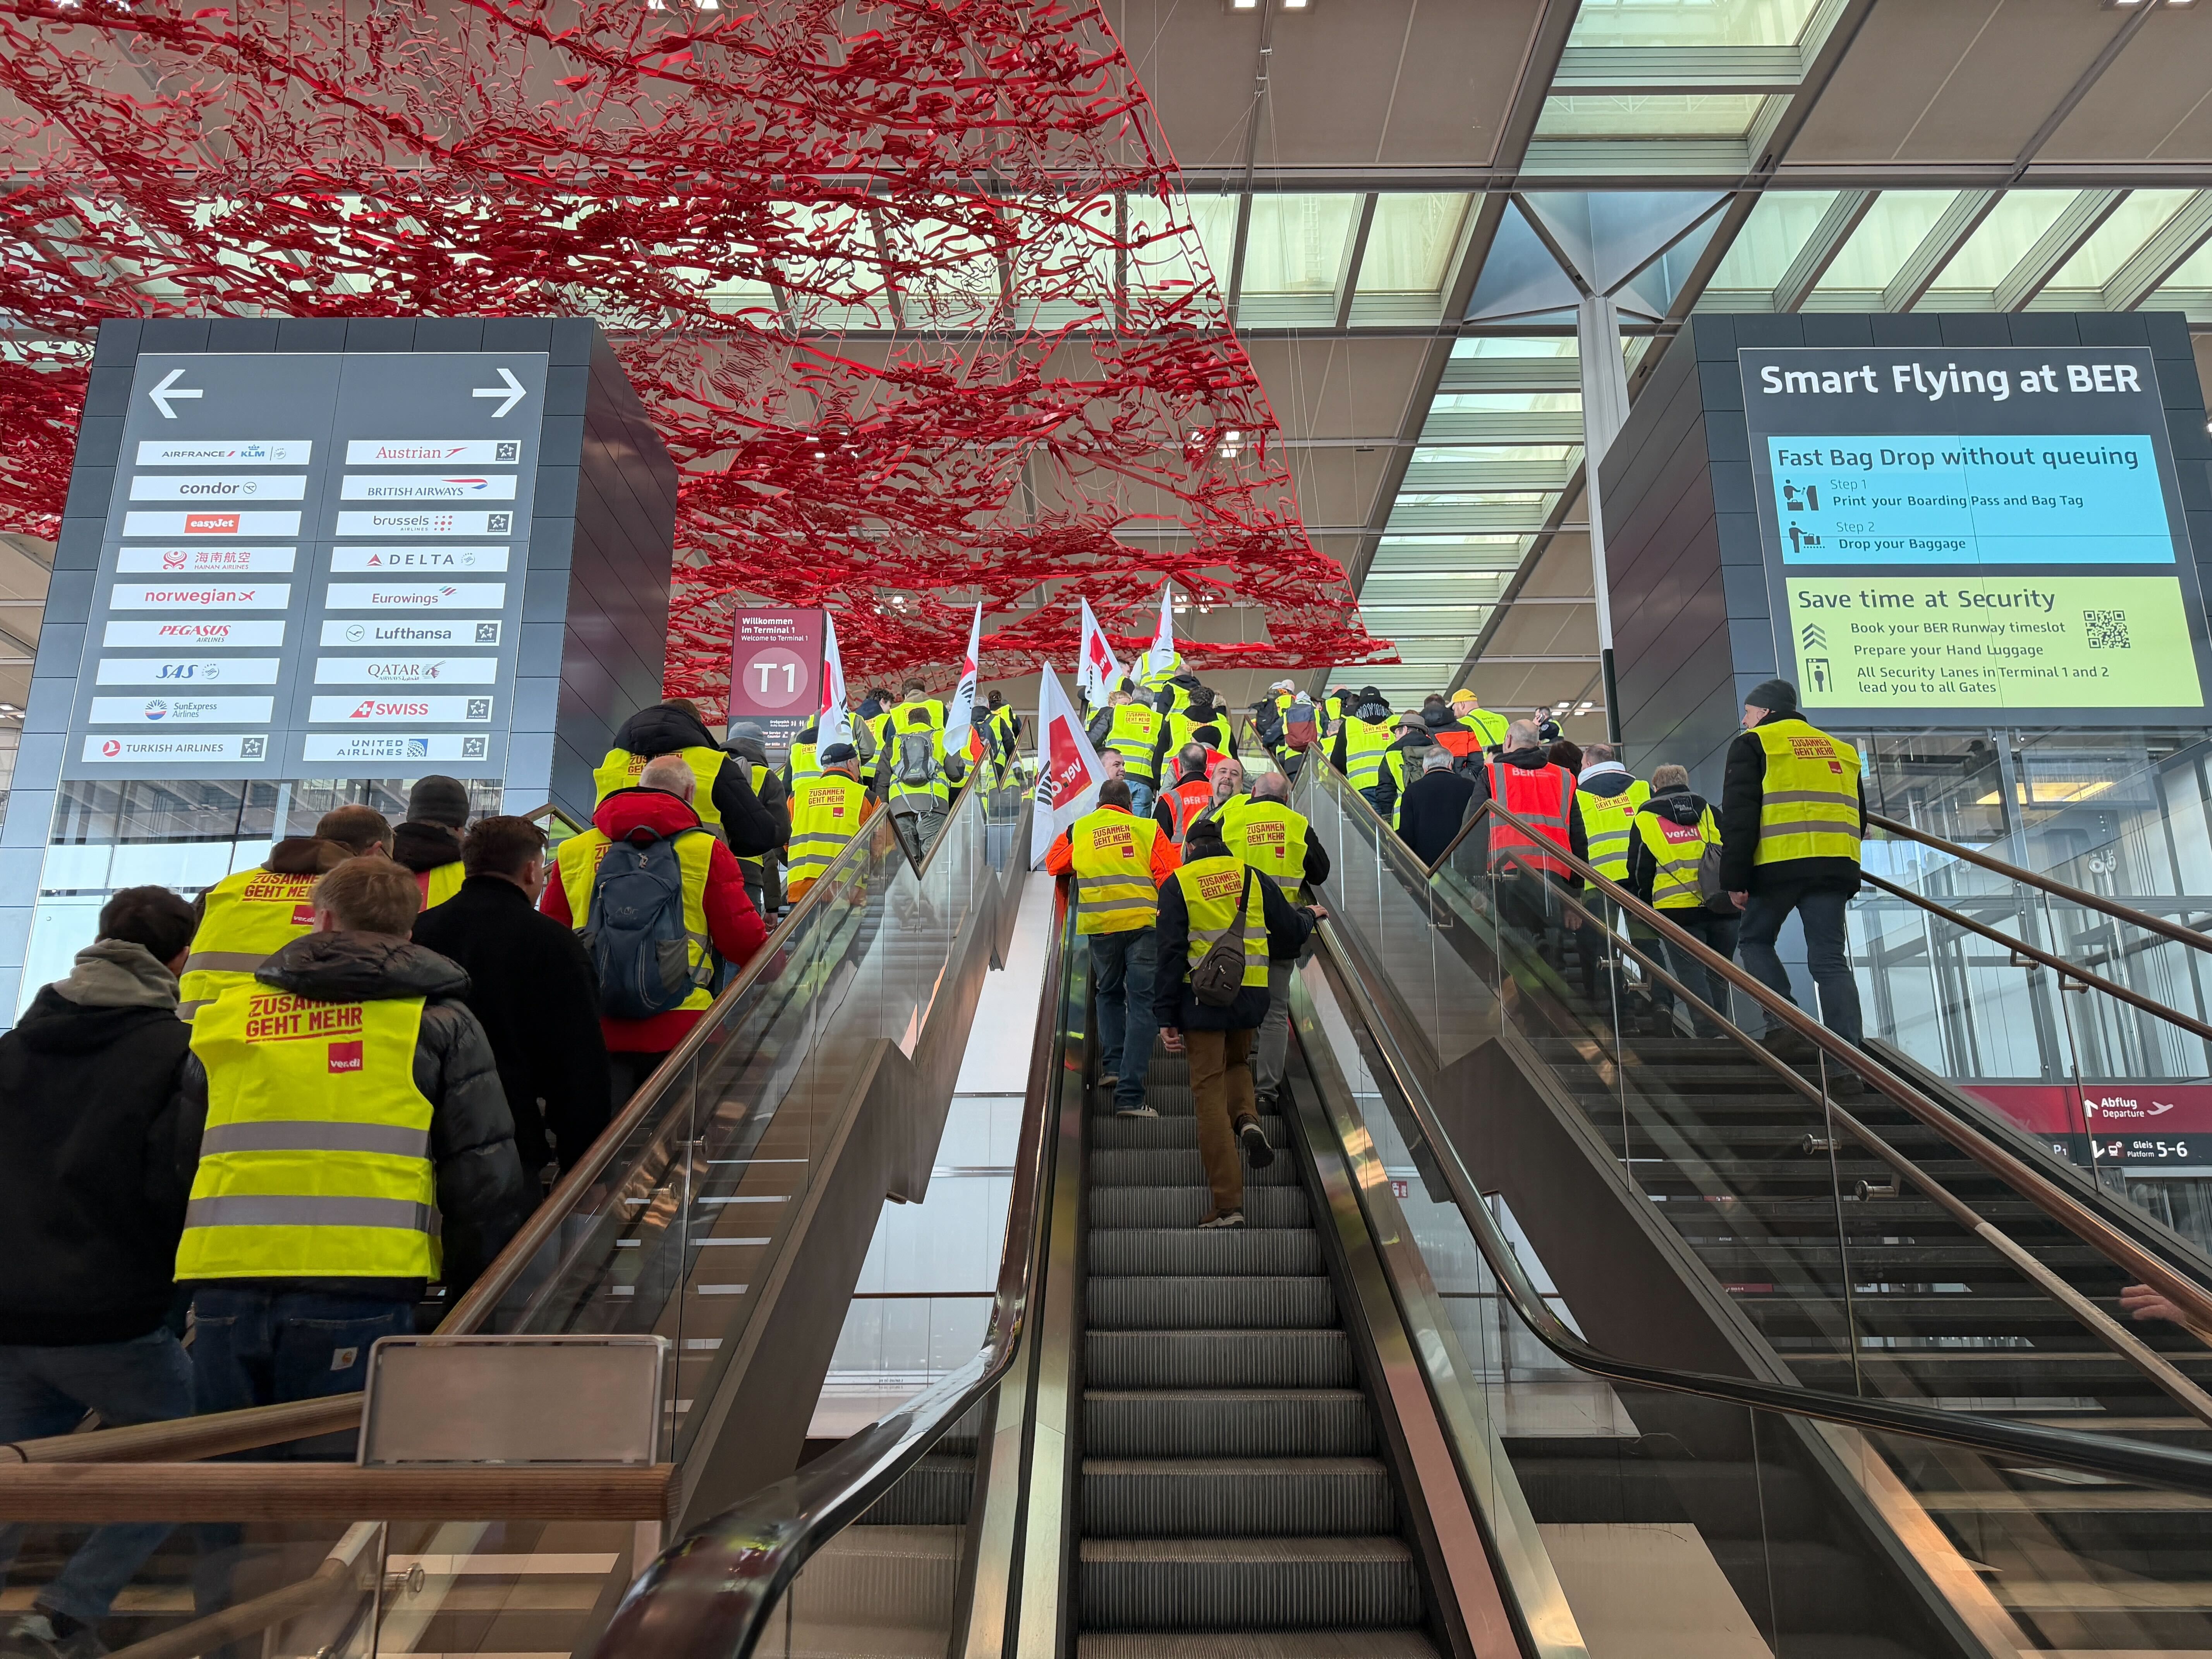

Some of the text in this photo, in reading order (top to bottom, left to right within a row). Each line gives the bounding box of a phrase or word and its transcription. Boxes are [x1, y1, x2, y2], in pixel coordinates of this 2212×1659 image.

[1761, 363, 2141, 401] Smart Flying at BER
[375, 447, 441, 459] Austrian
[1778, 447, 2138, 471] Fast Bag Drop without queuing
[180, 482, 240, 494] condor
[1831, 479, 1867, 491] Step 1
[368, 487, 464, 496] BRITISH AIRWAYS
[1833, 496, 2083, 508] Print your Boarding Pass and Bag Tag
[191, 519, 234, 529] easyJet
[373, 516, 429, 526] brussels
[1836, 522, 1875, 534] Step 2
[1839, 539, 1966, 551] Drop your Baggage
[195, 552, 251, 563] 海南航空
[389, 554, 454, 565] DELTA
[145, 589, 235, 605] norwegian
[372, 593, 438, 606] Eurowings
[1798, 589, 2055, 613] Save time at Security
[158, 625, 231, 636] PEGASUS
[375, 627, 452, 639] Lufthansa
[1851, 622, 2066, 635] Book your BER Runway timeslot
[1854, 644, 2043, 658] Prepare your Hand Luggage
[156, 665, 198, 678] SAS
[368, 664, 419, 678] QATAR
[1857, 666, 2109, 680] All Security Lanes in Terminal 1 and 2
[754, 663, 795, 692] T1
[1859, 681, 1996, 695] lead you to all Gates
[173, 702, 217, 711] SunExpress
[375, 703, 429, 715] SWISS
[126, 744, 223, 752] TURKISH AIRLINES
[1789, 738, 1831, 747] ZUSAMMEN
[1794, 747, 1836, 756] GEHT MEHR
[808, 797, 825, 805] GEHT
[1183, 796, 1201, 805] BER
[1595, 800, 1611, 809] GEHT
[1613, 796, 1630, 805] MEHR
[1092, 824, 1130, 839] ZUSAMMEN
[1247, 823, 1285, 835] ZUSAMMEN
[1094, 832, 1132, 847] GEHT MEHR
[1247, 832, 1285, 843] GEHT MEHR
[250, 873, 319, 884] ZUSAMME
[1198, 871, 1240, 888] ZUSAMMEN
[244, 885, 285, 898] GEHT
[1201, 880, 1242, 898] GEHT MEHR
[246, 1006, 363, 1037] GEHT MEHR
[330, 1058, 361, 1068] ver.di
[2101, 1097, 2137, 1109] Abflug
[2103, 1109, 2145, 1119] Departure
[2053, 1144, 2067, 1156] P1
[2157, 1141, 2188, 1158] 5-6
